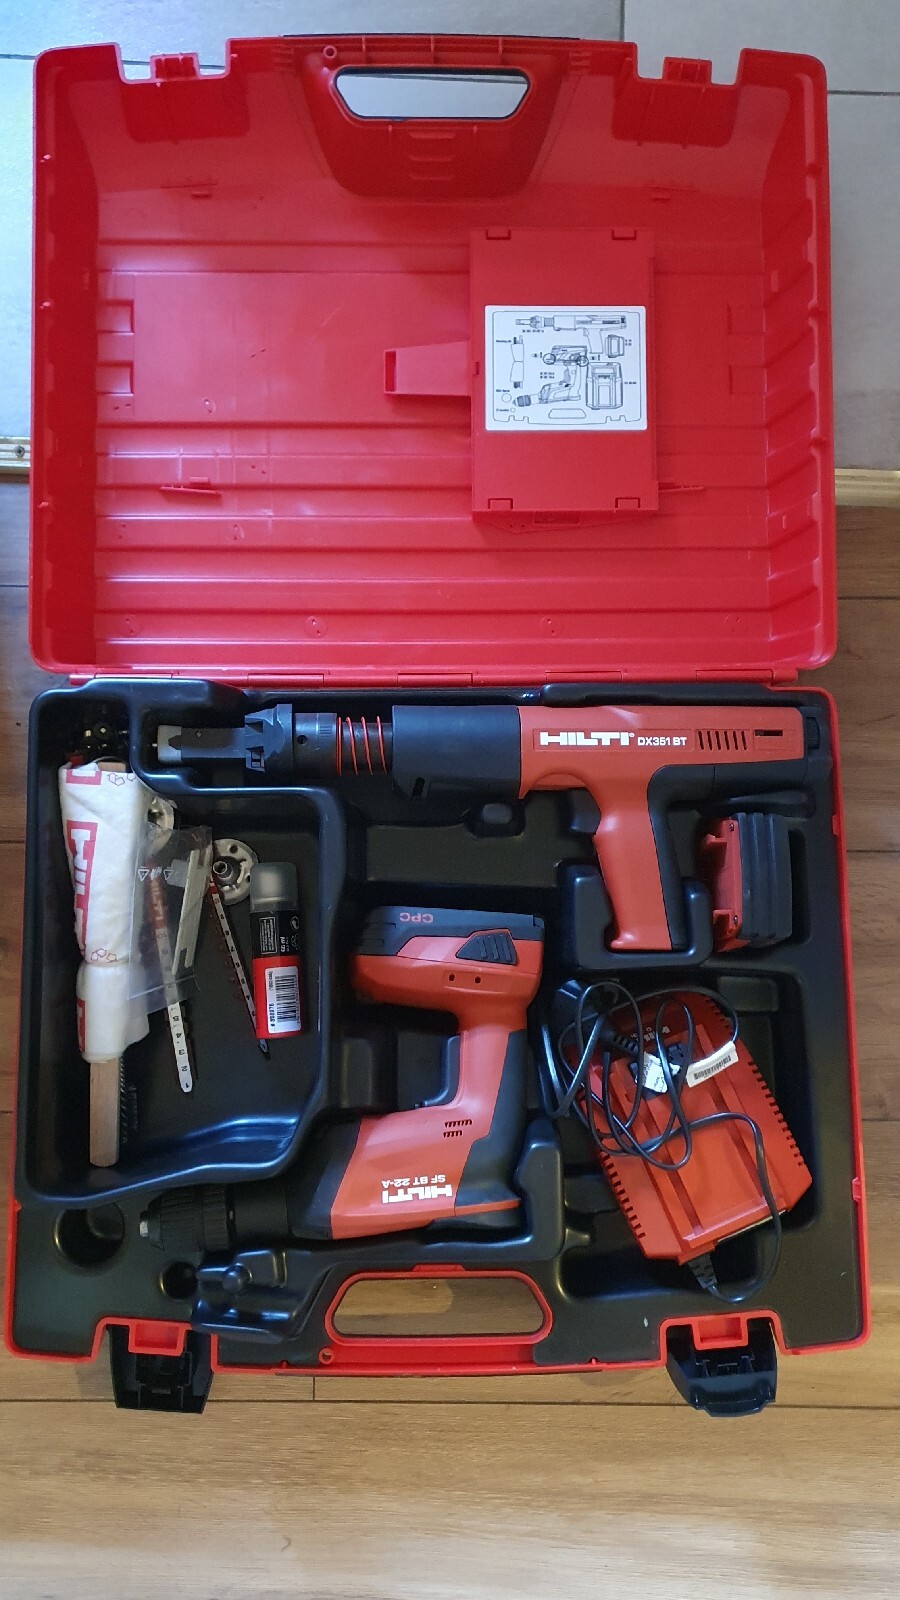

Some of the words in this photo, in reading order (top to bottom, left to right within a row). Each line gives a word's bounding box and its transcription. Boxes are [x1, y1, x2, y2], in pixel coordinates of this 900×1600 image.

[540, 731, 630, 746] HILTI
[637, 737, 671, 747] DX351
[673, 737, 687, 747] BT
[399, 912, 434, 924] CPC
[381, 1178, 411, 1188] 22-A
[413, 1176, 429, 1186] BT
[430, 1174, 445, 1184] SF
[382, 1184, 452, 1203] HILTI
